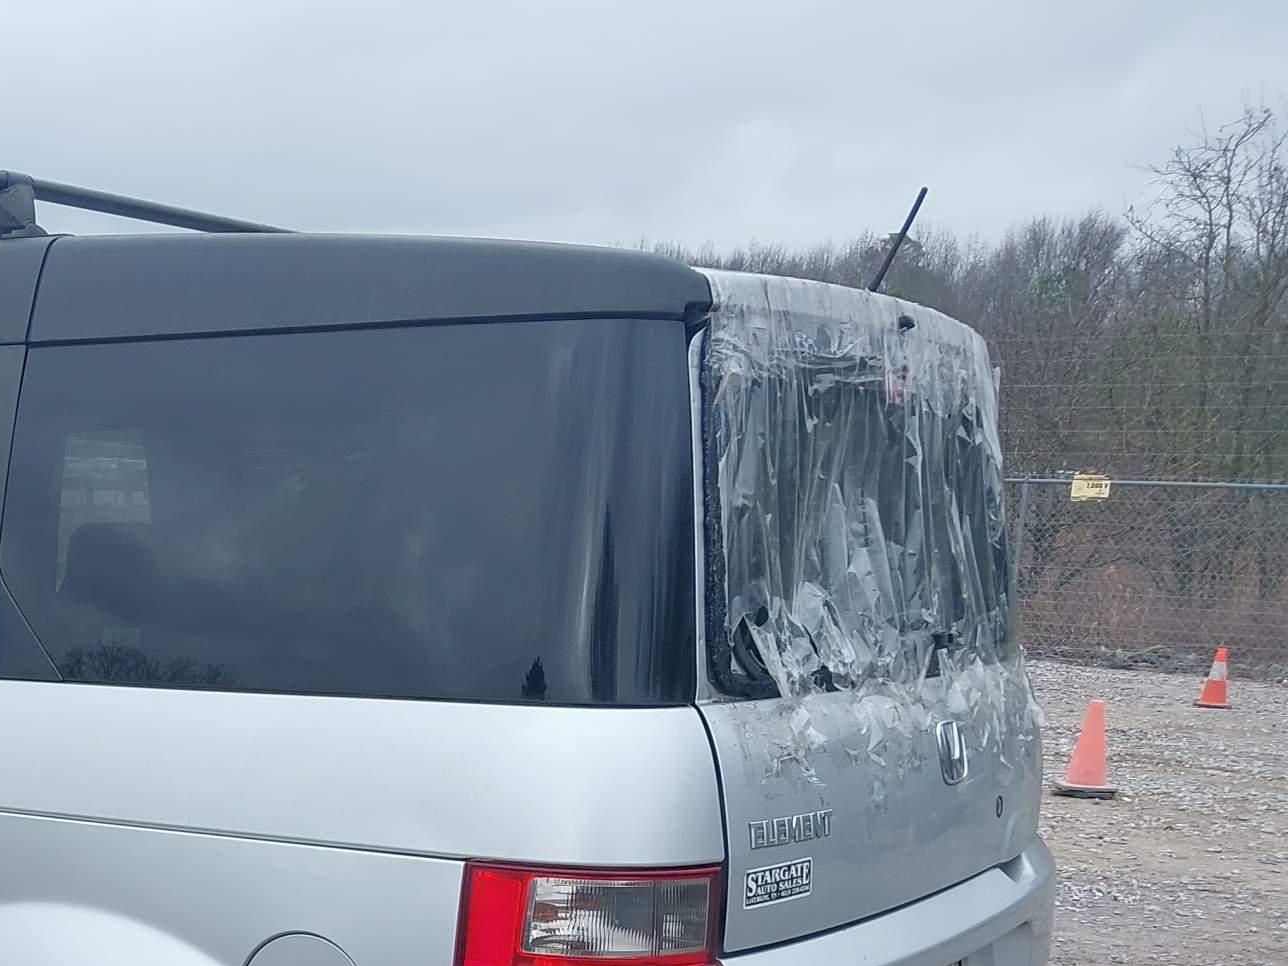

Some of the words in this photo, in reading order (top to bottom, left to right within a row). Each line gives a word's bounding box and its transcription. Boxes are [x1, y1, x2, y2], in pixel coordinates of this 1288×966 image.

[748, 809, 832, 850] ELEMENT
[747, 862, 810, 897] STARGATE
[756, 883, 777, 896] AUTO
[779, 877, 802, 891] SALES
